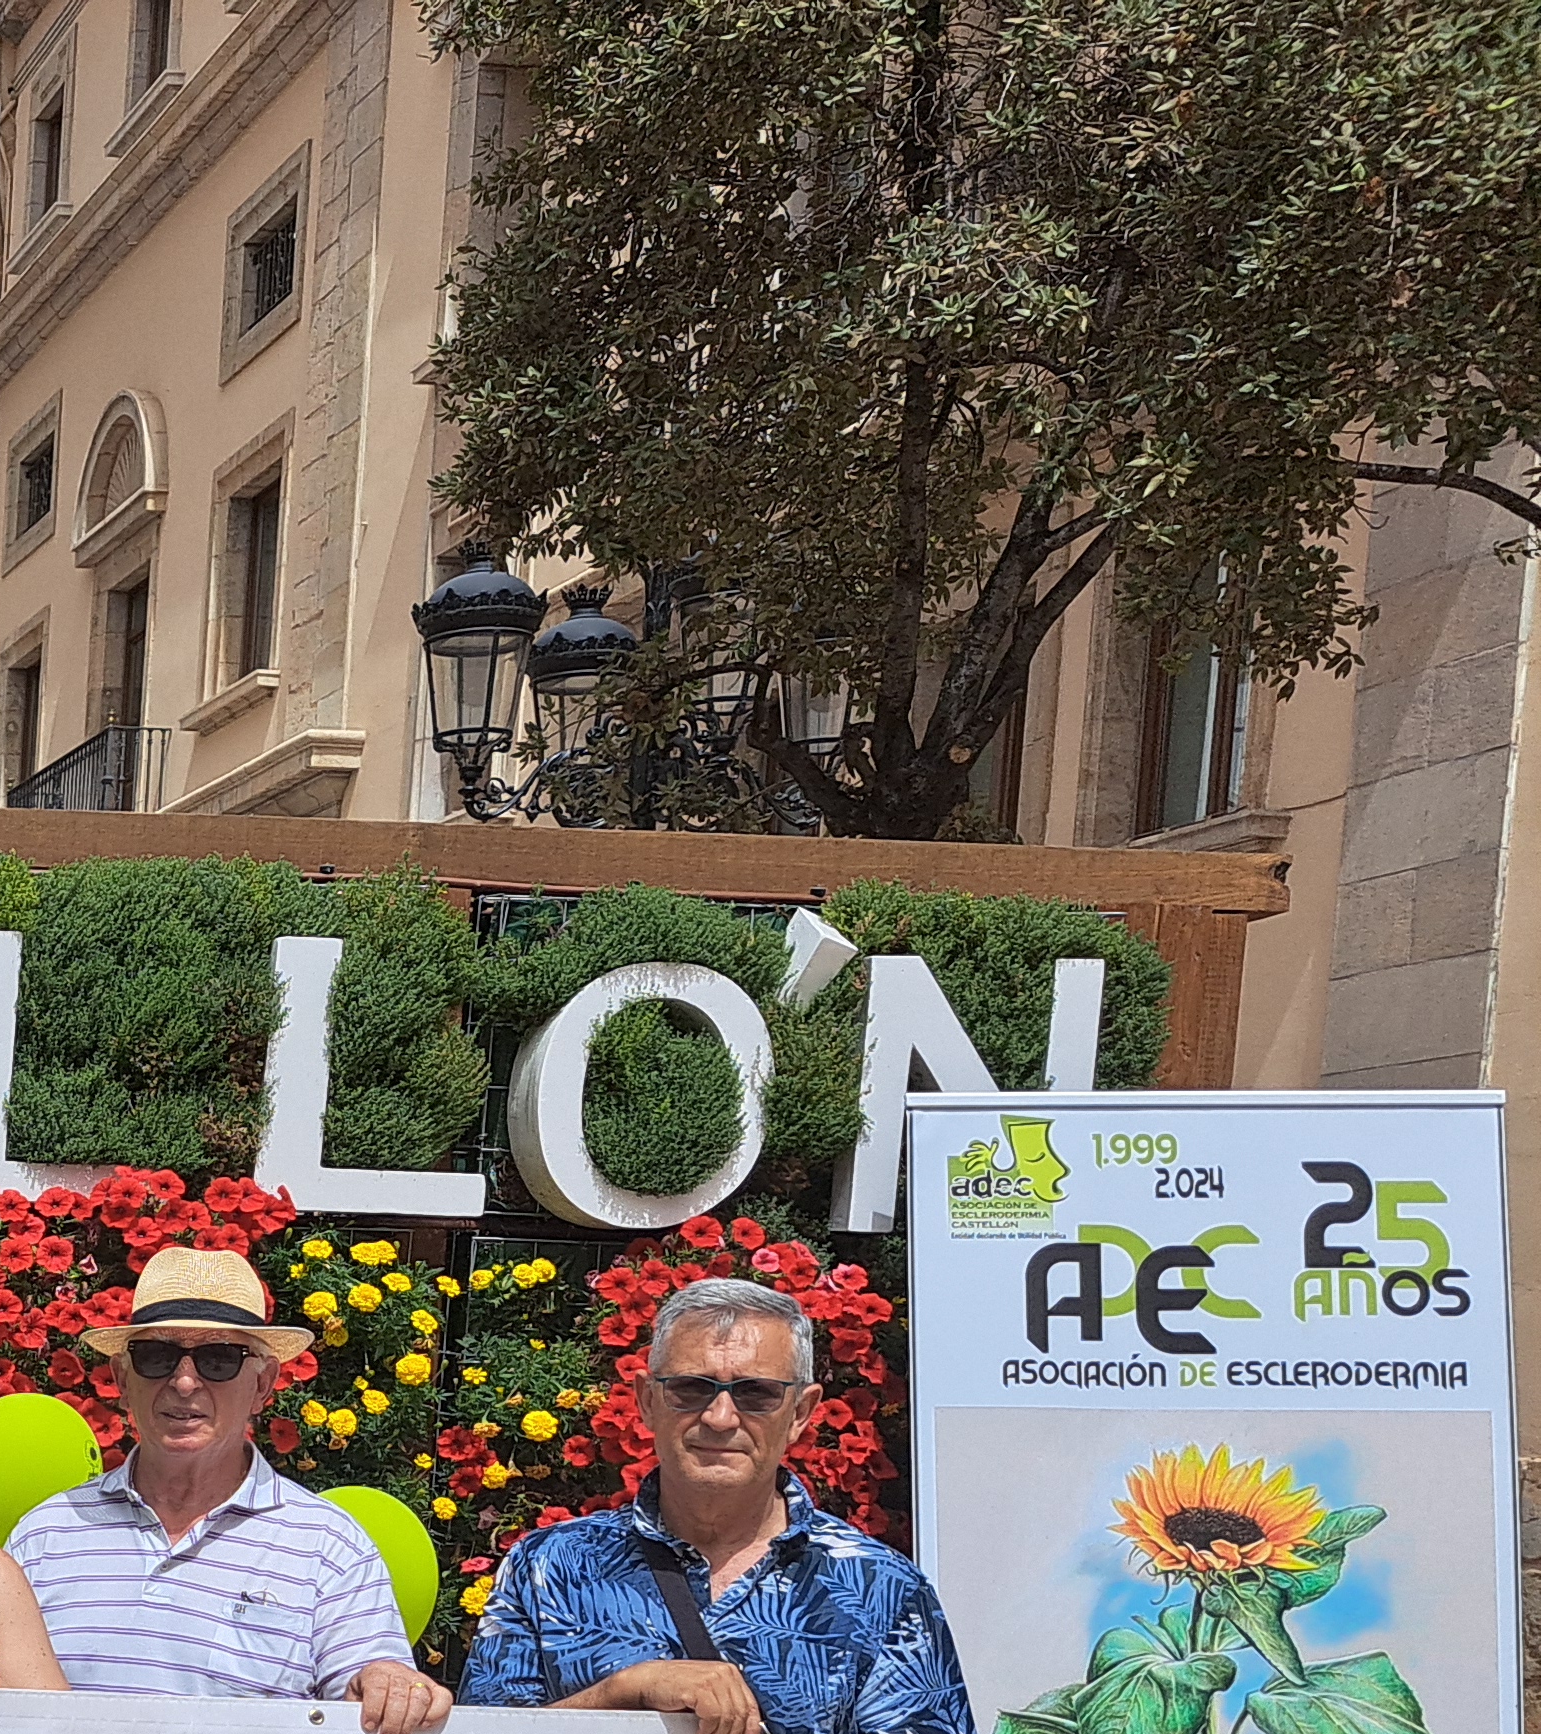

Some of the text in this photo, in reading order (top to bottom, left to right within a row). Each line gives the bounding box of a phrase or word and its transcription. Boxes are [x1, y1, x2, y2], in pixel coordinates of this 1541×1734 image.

[1091, 1133, 1178, 1170] 1.999
[951, 1170, 1033, 1199] adec
[1153, 1165, 1225, 1199] 2.024
[951, 1201, 1038, 1210] ASOCIACIÓN DE
[951, 1211, 1050, 1219] ESCLERODERMIA
[951, 1220, 1019, 1229] CASTELLÓN
[1301, 1160, 1452, 1290] 25
[1293, 1250, 1472, 1323] AÑOS
[1002, 1353, 1469, 1390] ASOCIACIÓN DE ESCLERODERMIA
